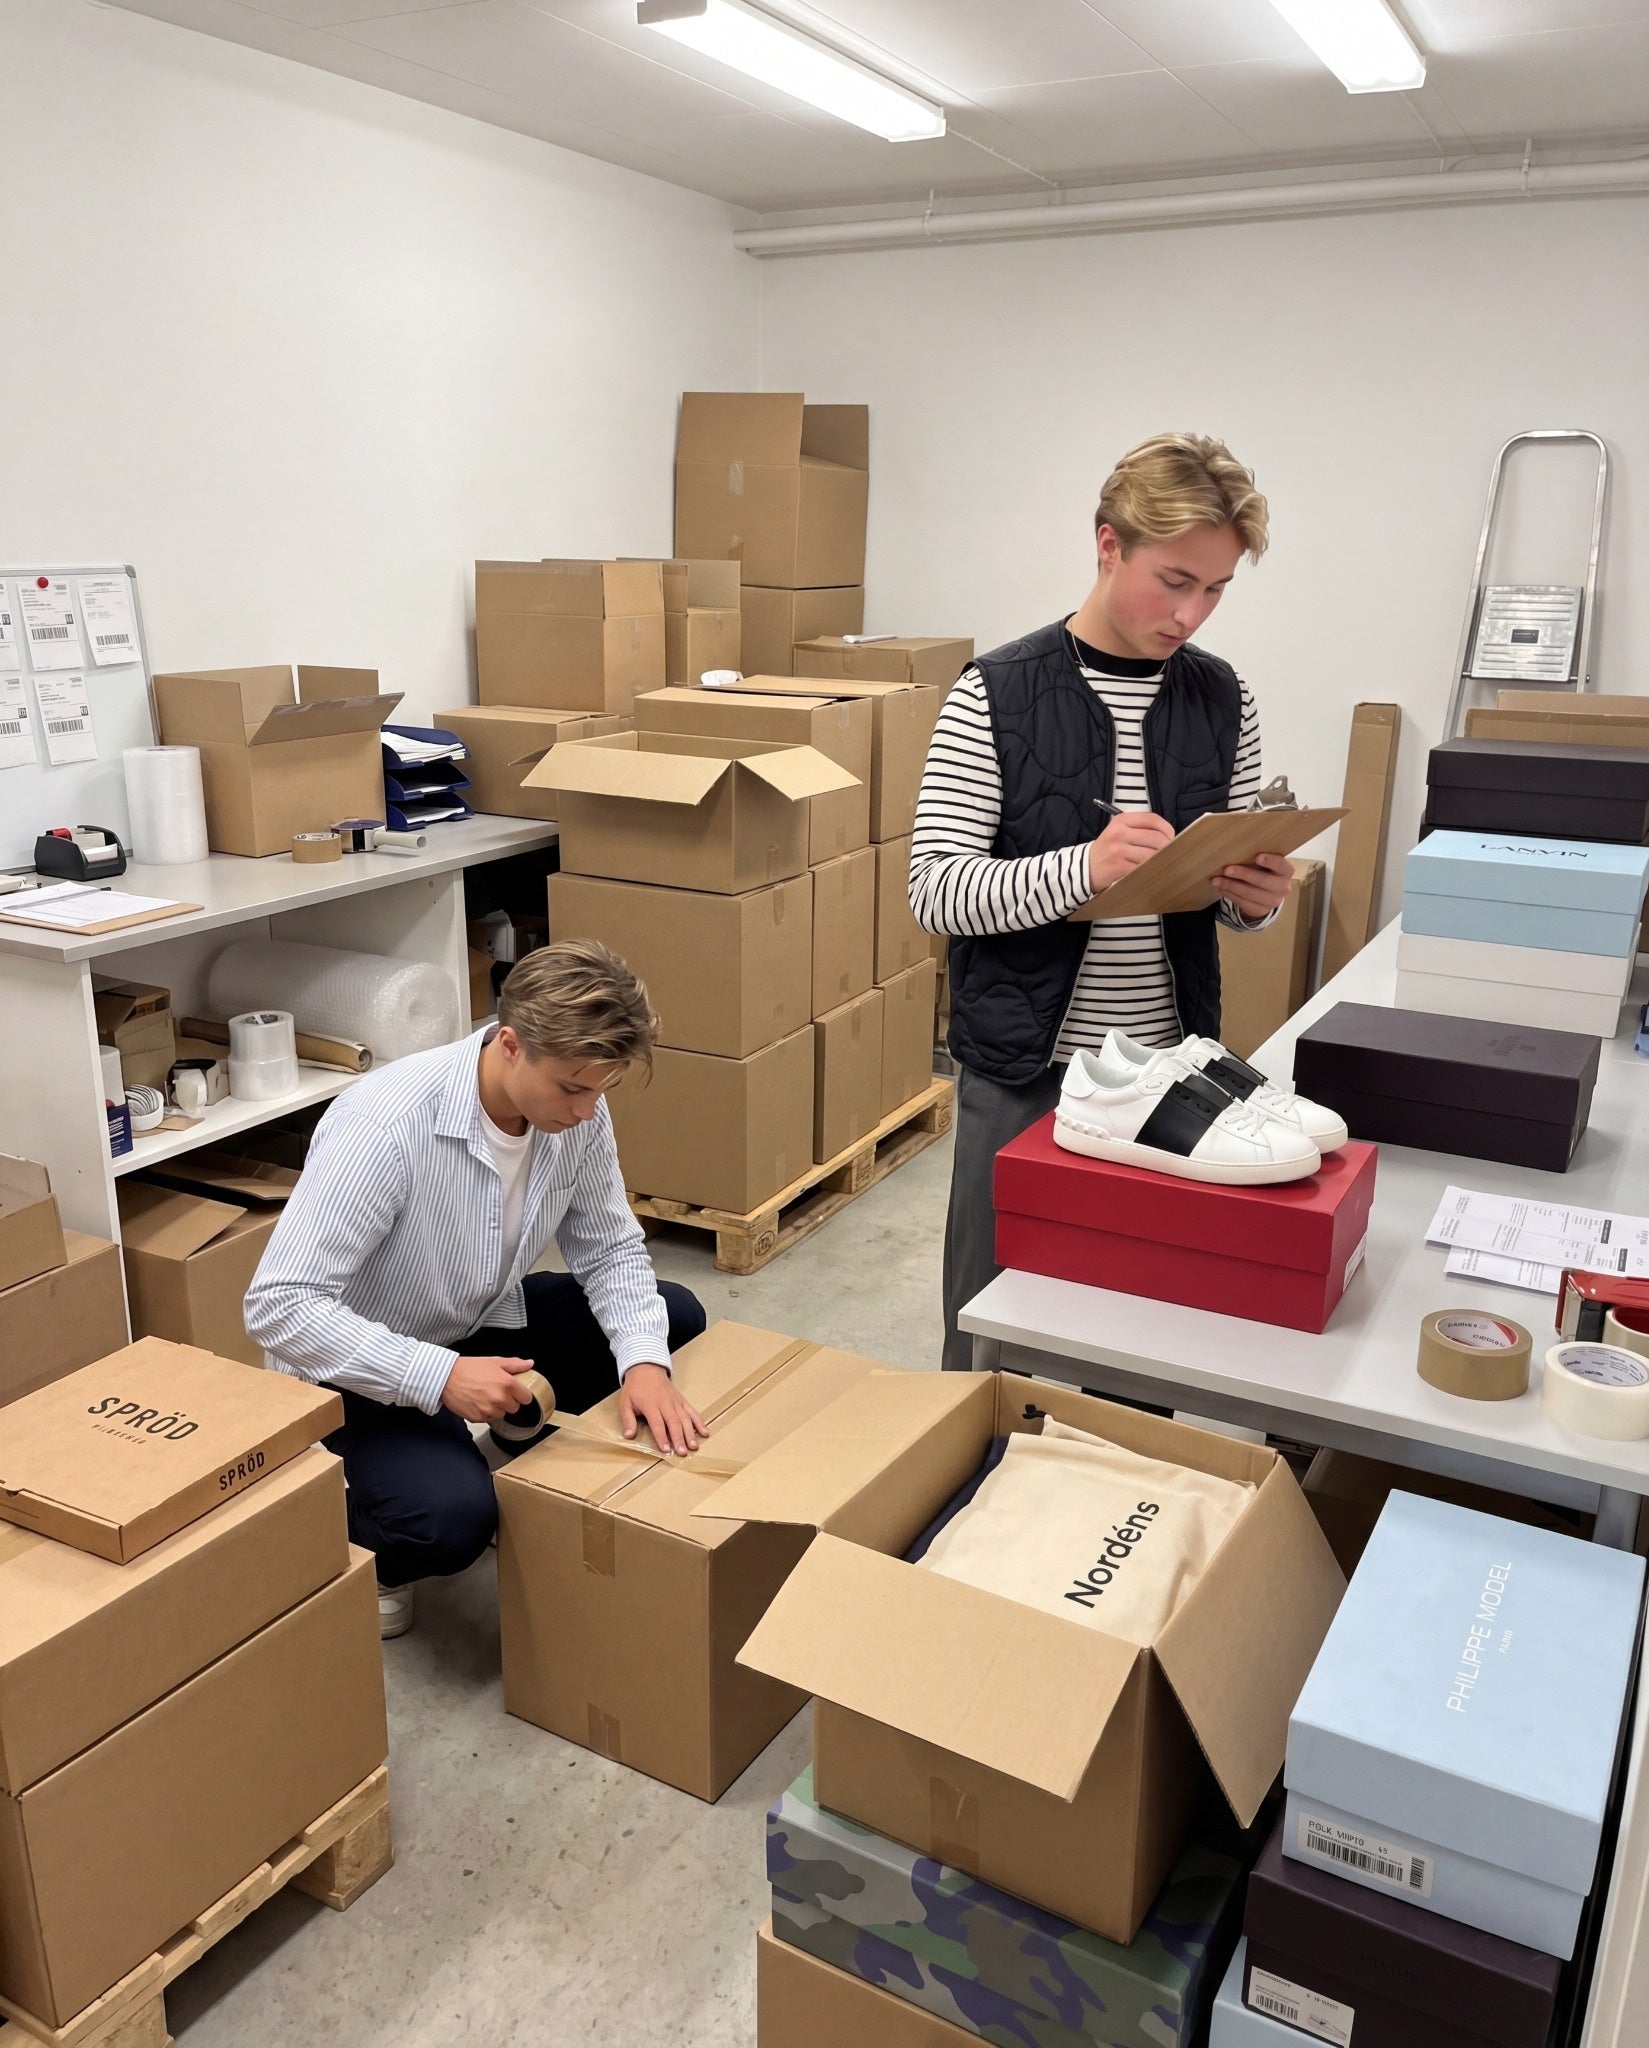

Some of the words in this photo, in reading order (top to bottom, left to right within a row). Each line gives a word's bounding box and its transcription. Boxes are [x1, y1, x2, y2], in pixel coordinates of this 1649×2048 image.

[1481, 844, 1588, 858] LANVIN
[87, 1397, 199, 1440] SPRÖD
[218, 1451, 265, 1490] SPRÖD
[1064, 1501, 1160, 1608] Nordéns
[1445, 1622, 1492, 1714] PHILIPPE
[1477, 1560, 1512, 1622] MODEL
